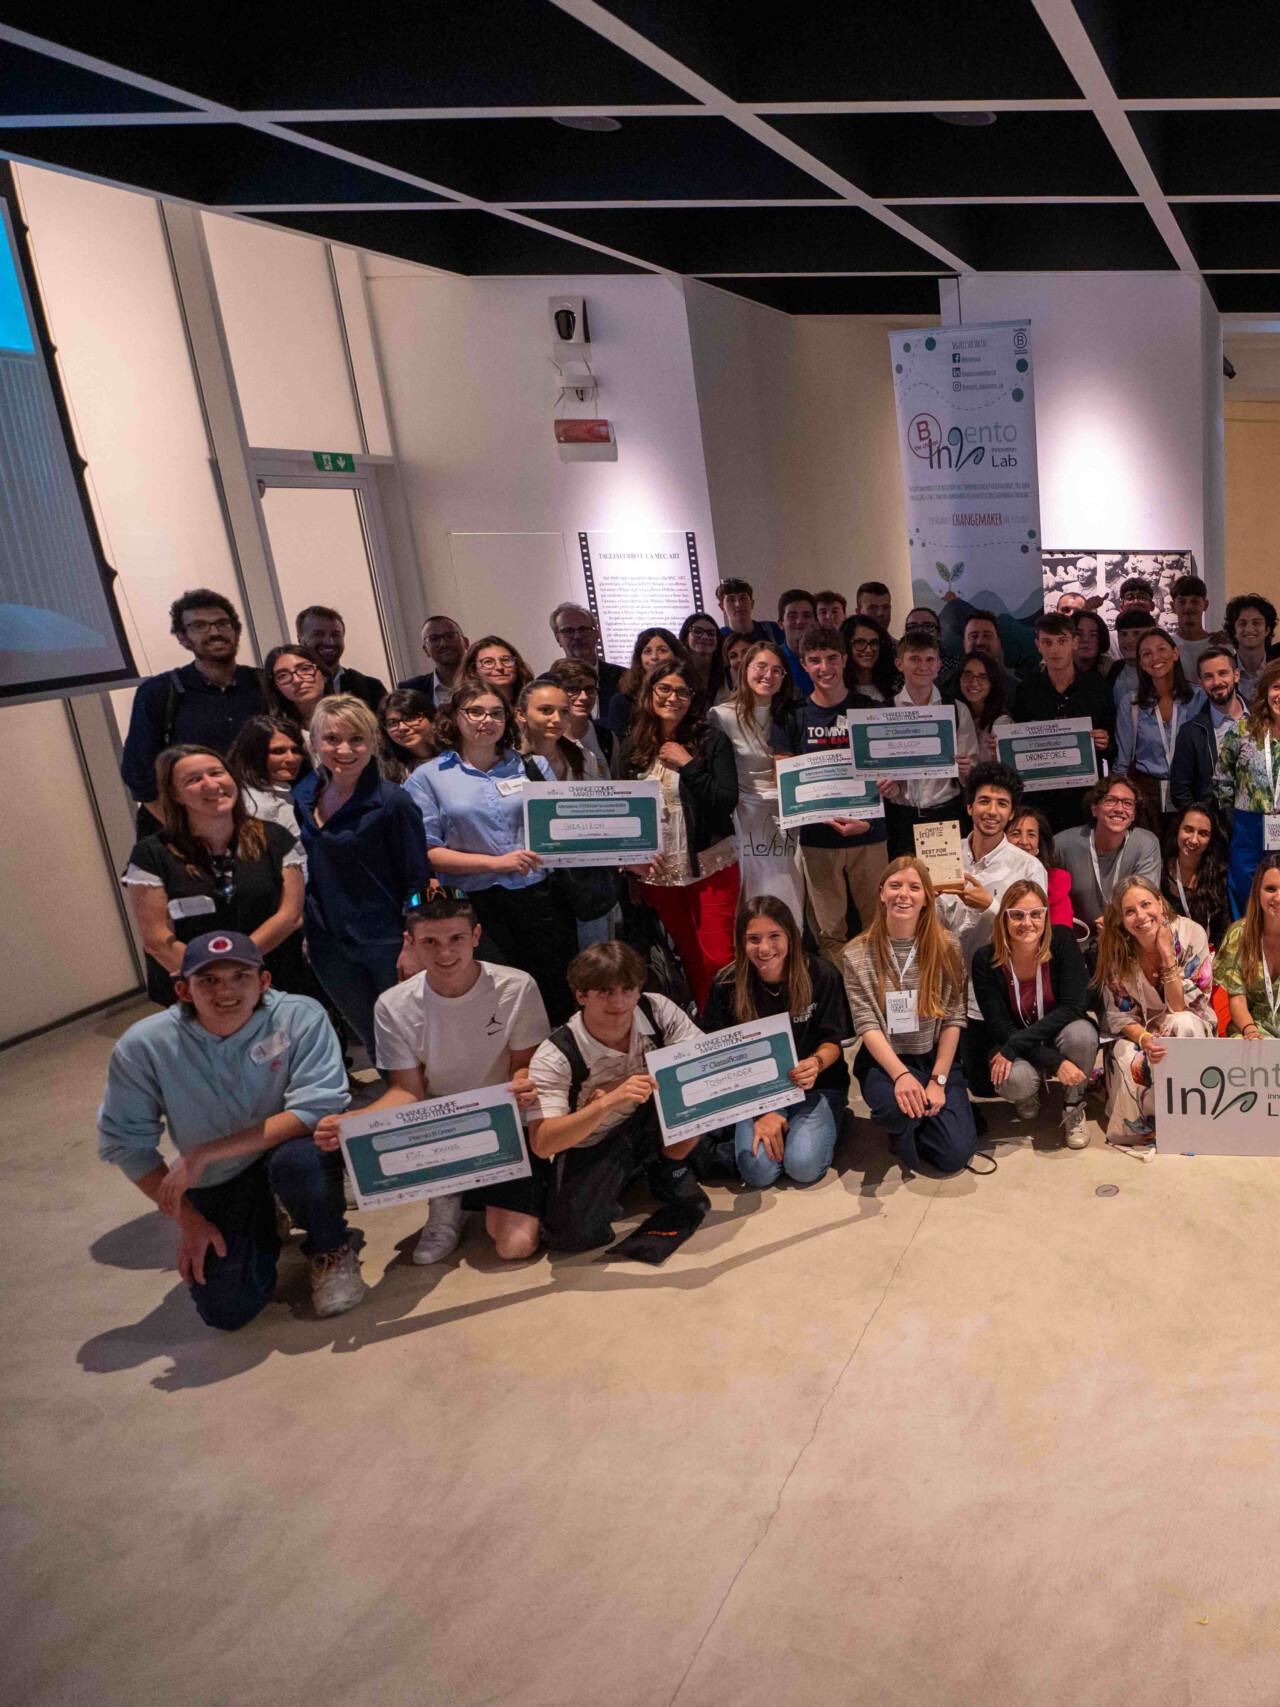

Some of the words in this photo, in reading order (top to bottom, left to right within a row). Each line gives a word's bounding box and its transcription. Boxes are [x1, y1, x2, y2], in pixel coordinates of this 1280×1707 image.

[917, 420, 931, 442] B
[991, 454, 1018, 468] Lab
[952, 513, 1003, 527] CHANGEMAKER
[808, 726, 848, 738] TOMM
[891, 727, 921, 735] Classificato
[1034, 740, 1061, 748] Classificato
[1025, 750, 1067, 762] DRONEFORCE
[694, 1036, 718, 1050] CHANGE
[718, 1030, 744, 1043] COMPE
[708, 1052, 748, 1069] Classificato
[704, 1067, 754, 1089] TOGHENDER
[395, 1107, 425, 1120] CHANGE
[425, 1100, 457, 1114] COMPE
[402, 1114, 430, 1124] MAKER
[430, 1108, 456, 1119] TITION
[408, 1132, 432, 1143] Premio
[438, 1126, 457, 1136] Green
[431, 1142, 460, 1155] YOUNG
